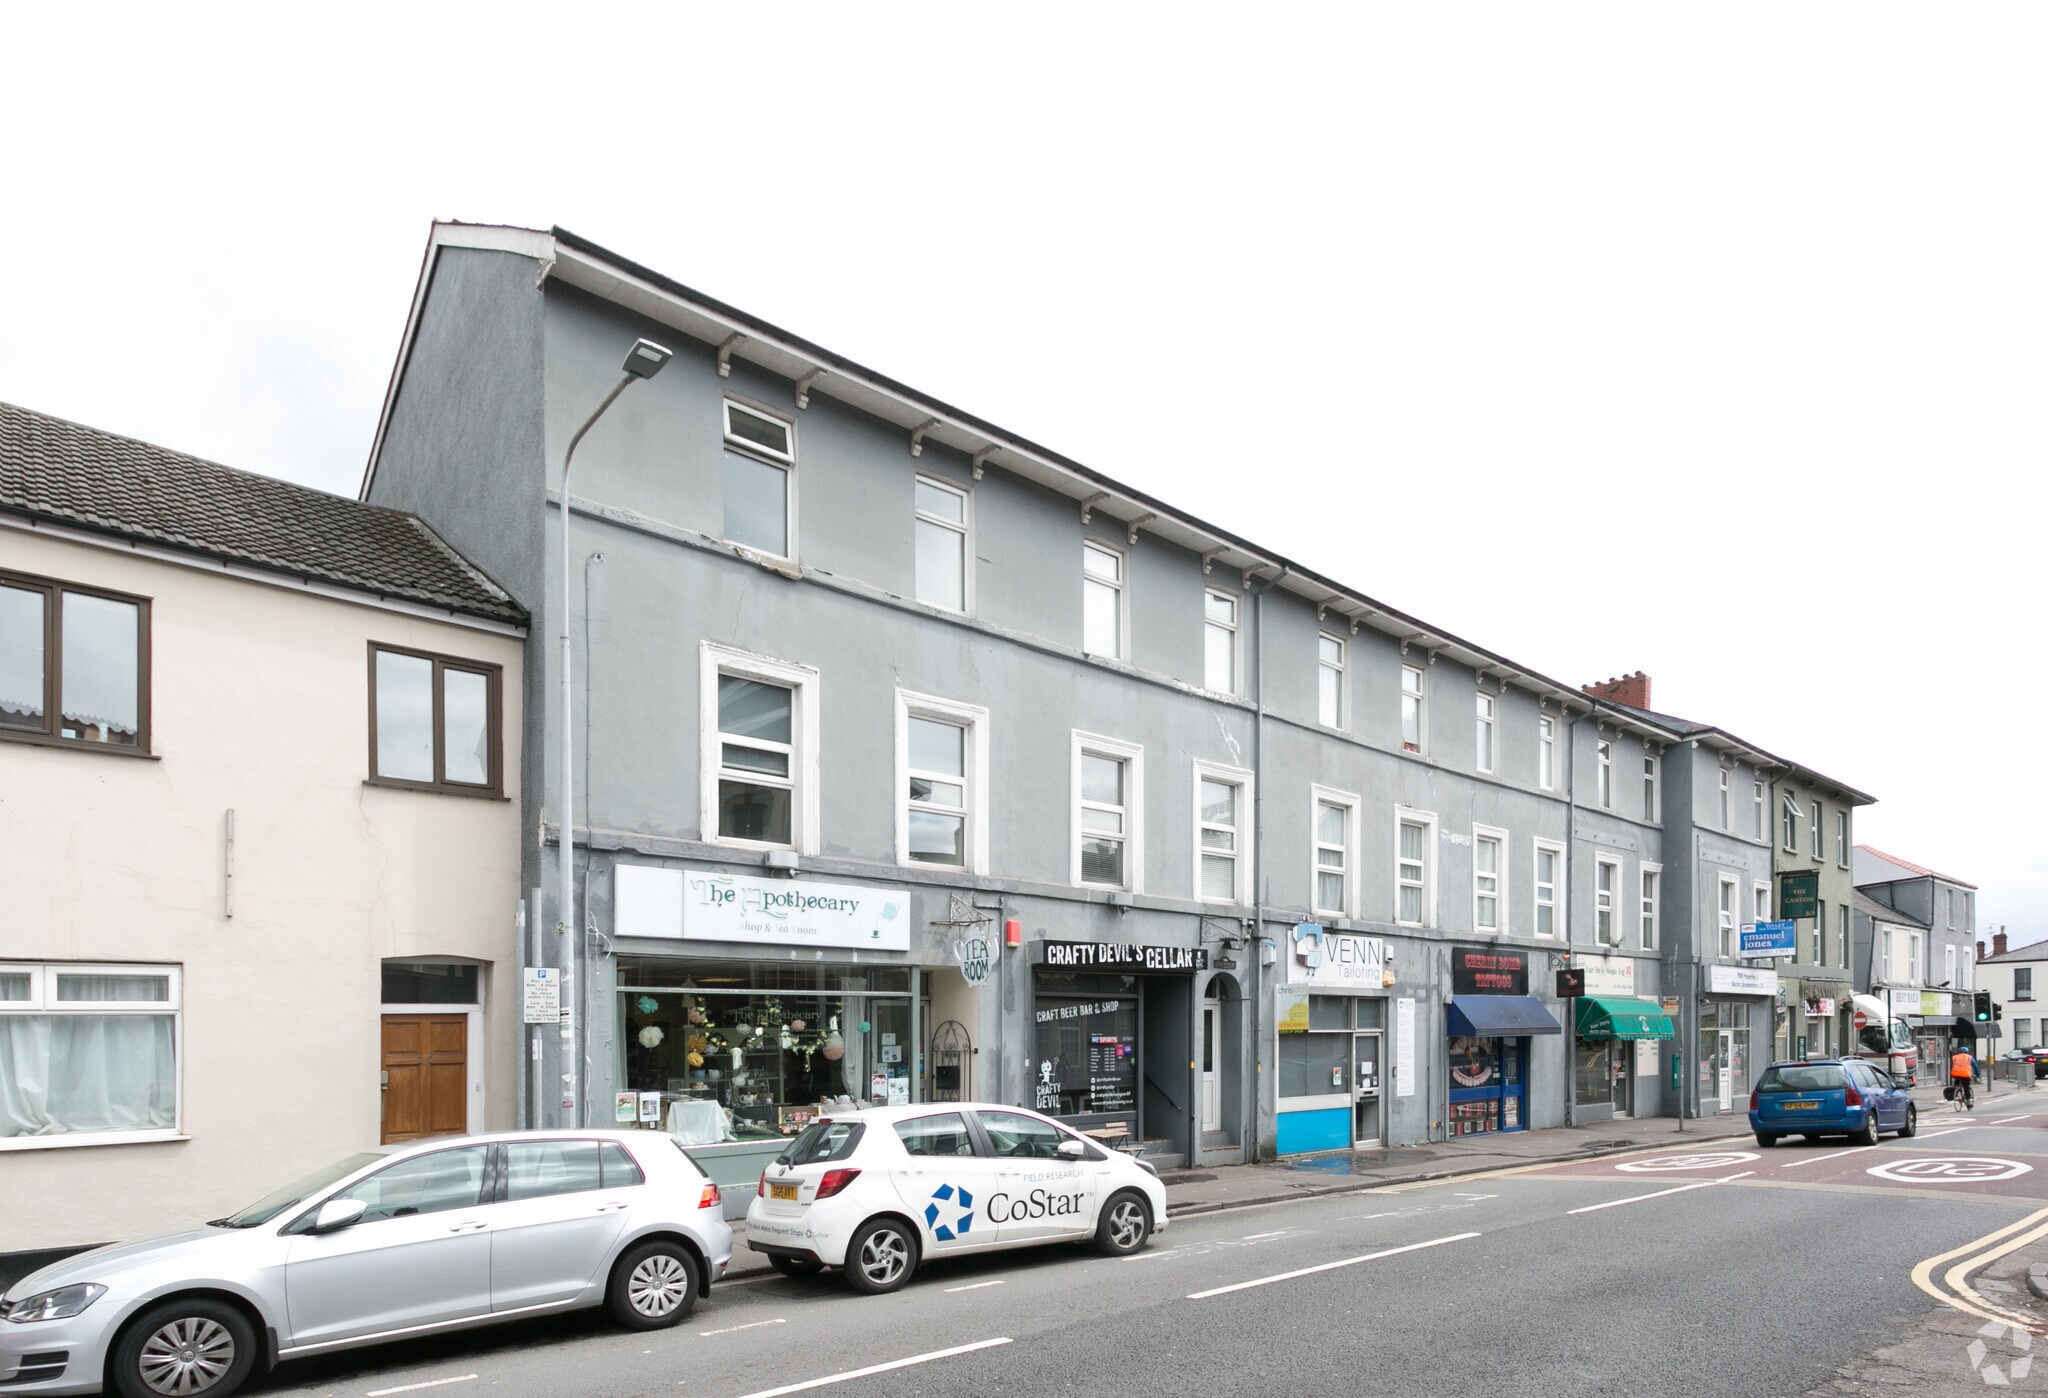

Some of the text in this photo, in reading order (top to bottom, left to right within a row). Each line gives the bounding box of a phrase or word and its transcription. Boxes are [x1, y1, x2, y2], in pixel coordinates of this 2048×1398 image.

[690, 876, 860, 919] The Apothecary
[558, 922, 564, 932] 2
[740, 921, 763, 933] Shop
[764, 923, 771, 933] &
[1743, 931, 1785, 941] emanuel
[964, 939, 989, 960] TEA
[1325, 937, 1380, 965] VENN
[1744, 940, 1772, 950] jones
[1047, 944, 1095, 965] CRAFTY
[1098, 943, 1144, 963] DEVIL'S
[1146, 948, 1193, 969] CELLAR
[1465, 954, 1497, 970] CHERRY
[964, 959, 989, 981] ROOM
[1337, 964, 1380, 980] Tailoring
[1475, 973, 1512, 988] TATTOOS
[729, 1007, 753, 1021] The
[1036, 1009, 1059, 1022] CRAFT
[1060, 1006, 1078, 1019] BEER
[1079, 1003, 1093, 1016] BAR
[1102, 1001, 1119, 1013] SHOP
[1036, 1082, 1061, 1095] CRAFTY
[1036, 1095, 1061, 1108] DEVIL
[1023, 1170, 1083, 1182] FIELD RESEARCH
[987, 1188, 1085, 1223] CoStar
[790, 1228, 804, 1237] Stops
